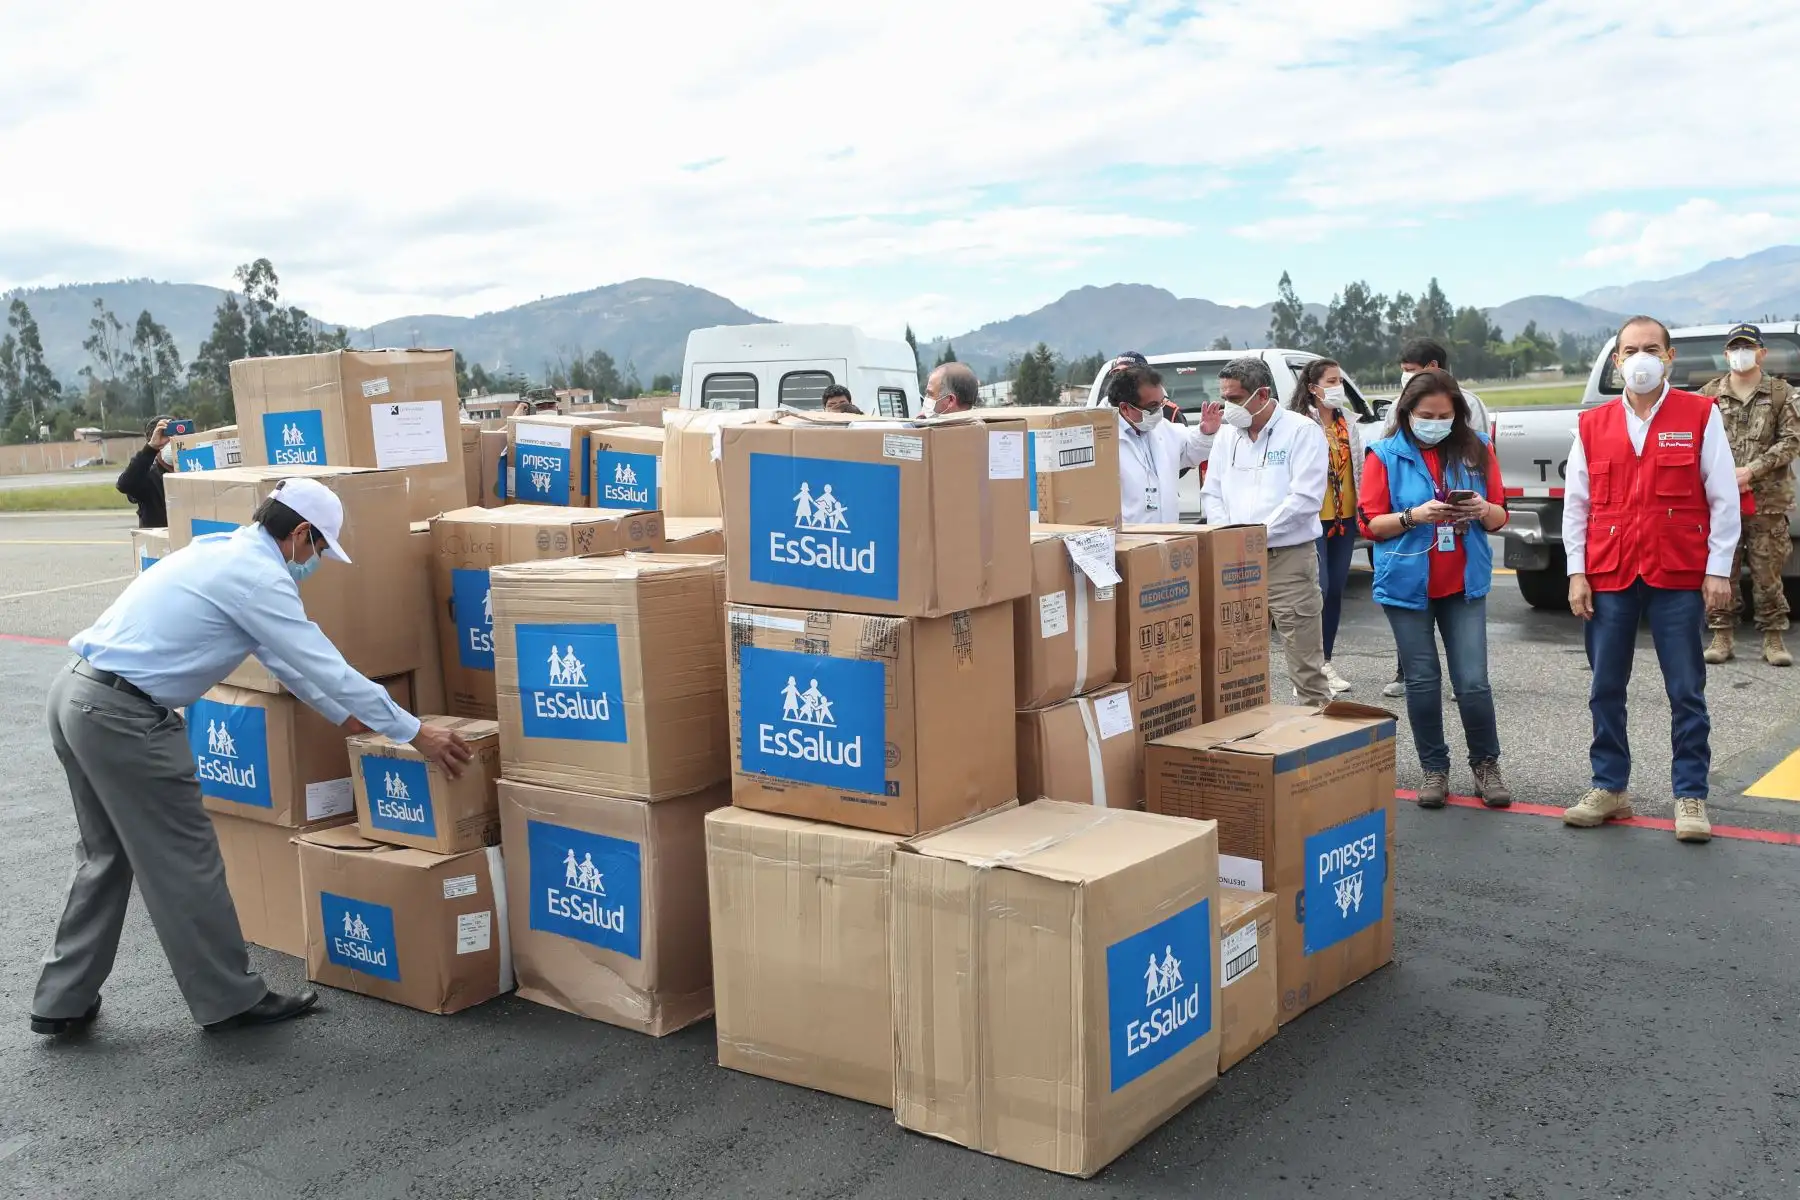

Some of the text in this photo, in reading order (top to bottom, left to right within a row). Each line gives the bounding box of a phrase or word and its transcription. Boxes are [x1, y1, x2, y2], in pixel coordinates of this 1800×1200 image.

[276, 448, 317, 465] EsSalud
[522, 454, 561, 472] EsSalud
[605, 485, 648, 503] EsSalud
[771, 532, 875, 574] EsSalud
[1141, 584, 1188, 605] MEDICLOTHS
[535, 692, 610, 720] EsSalud
[760, 724, 862, 768] EsSalud
[198, 755, 256, 788] EsSalud
[377, 799, 424, 823] EsSalud
[1319, 832, 1376, 883] EsSalud
[548, 888, 625, 934] EsSalud
[335, 937, 387, 967] EsSalud
[1127, 982, 1199, 1057] EsSalud
